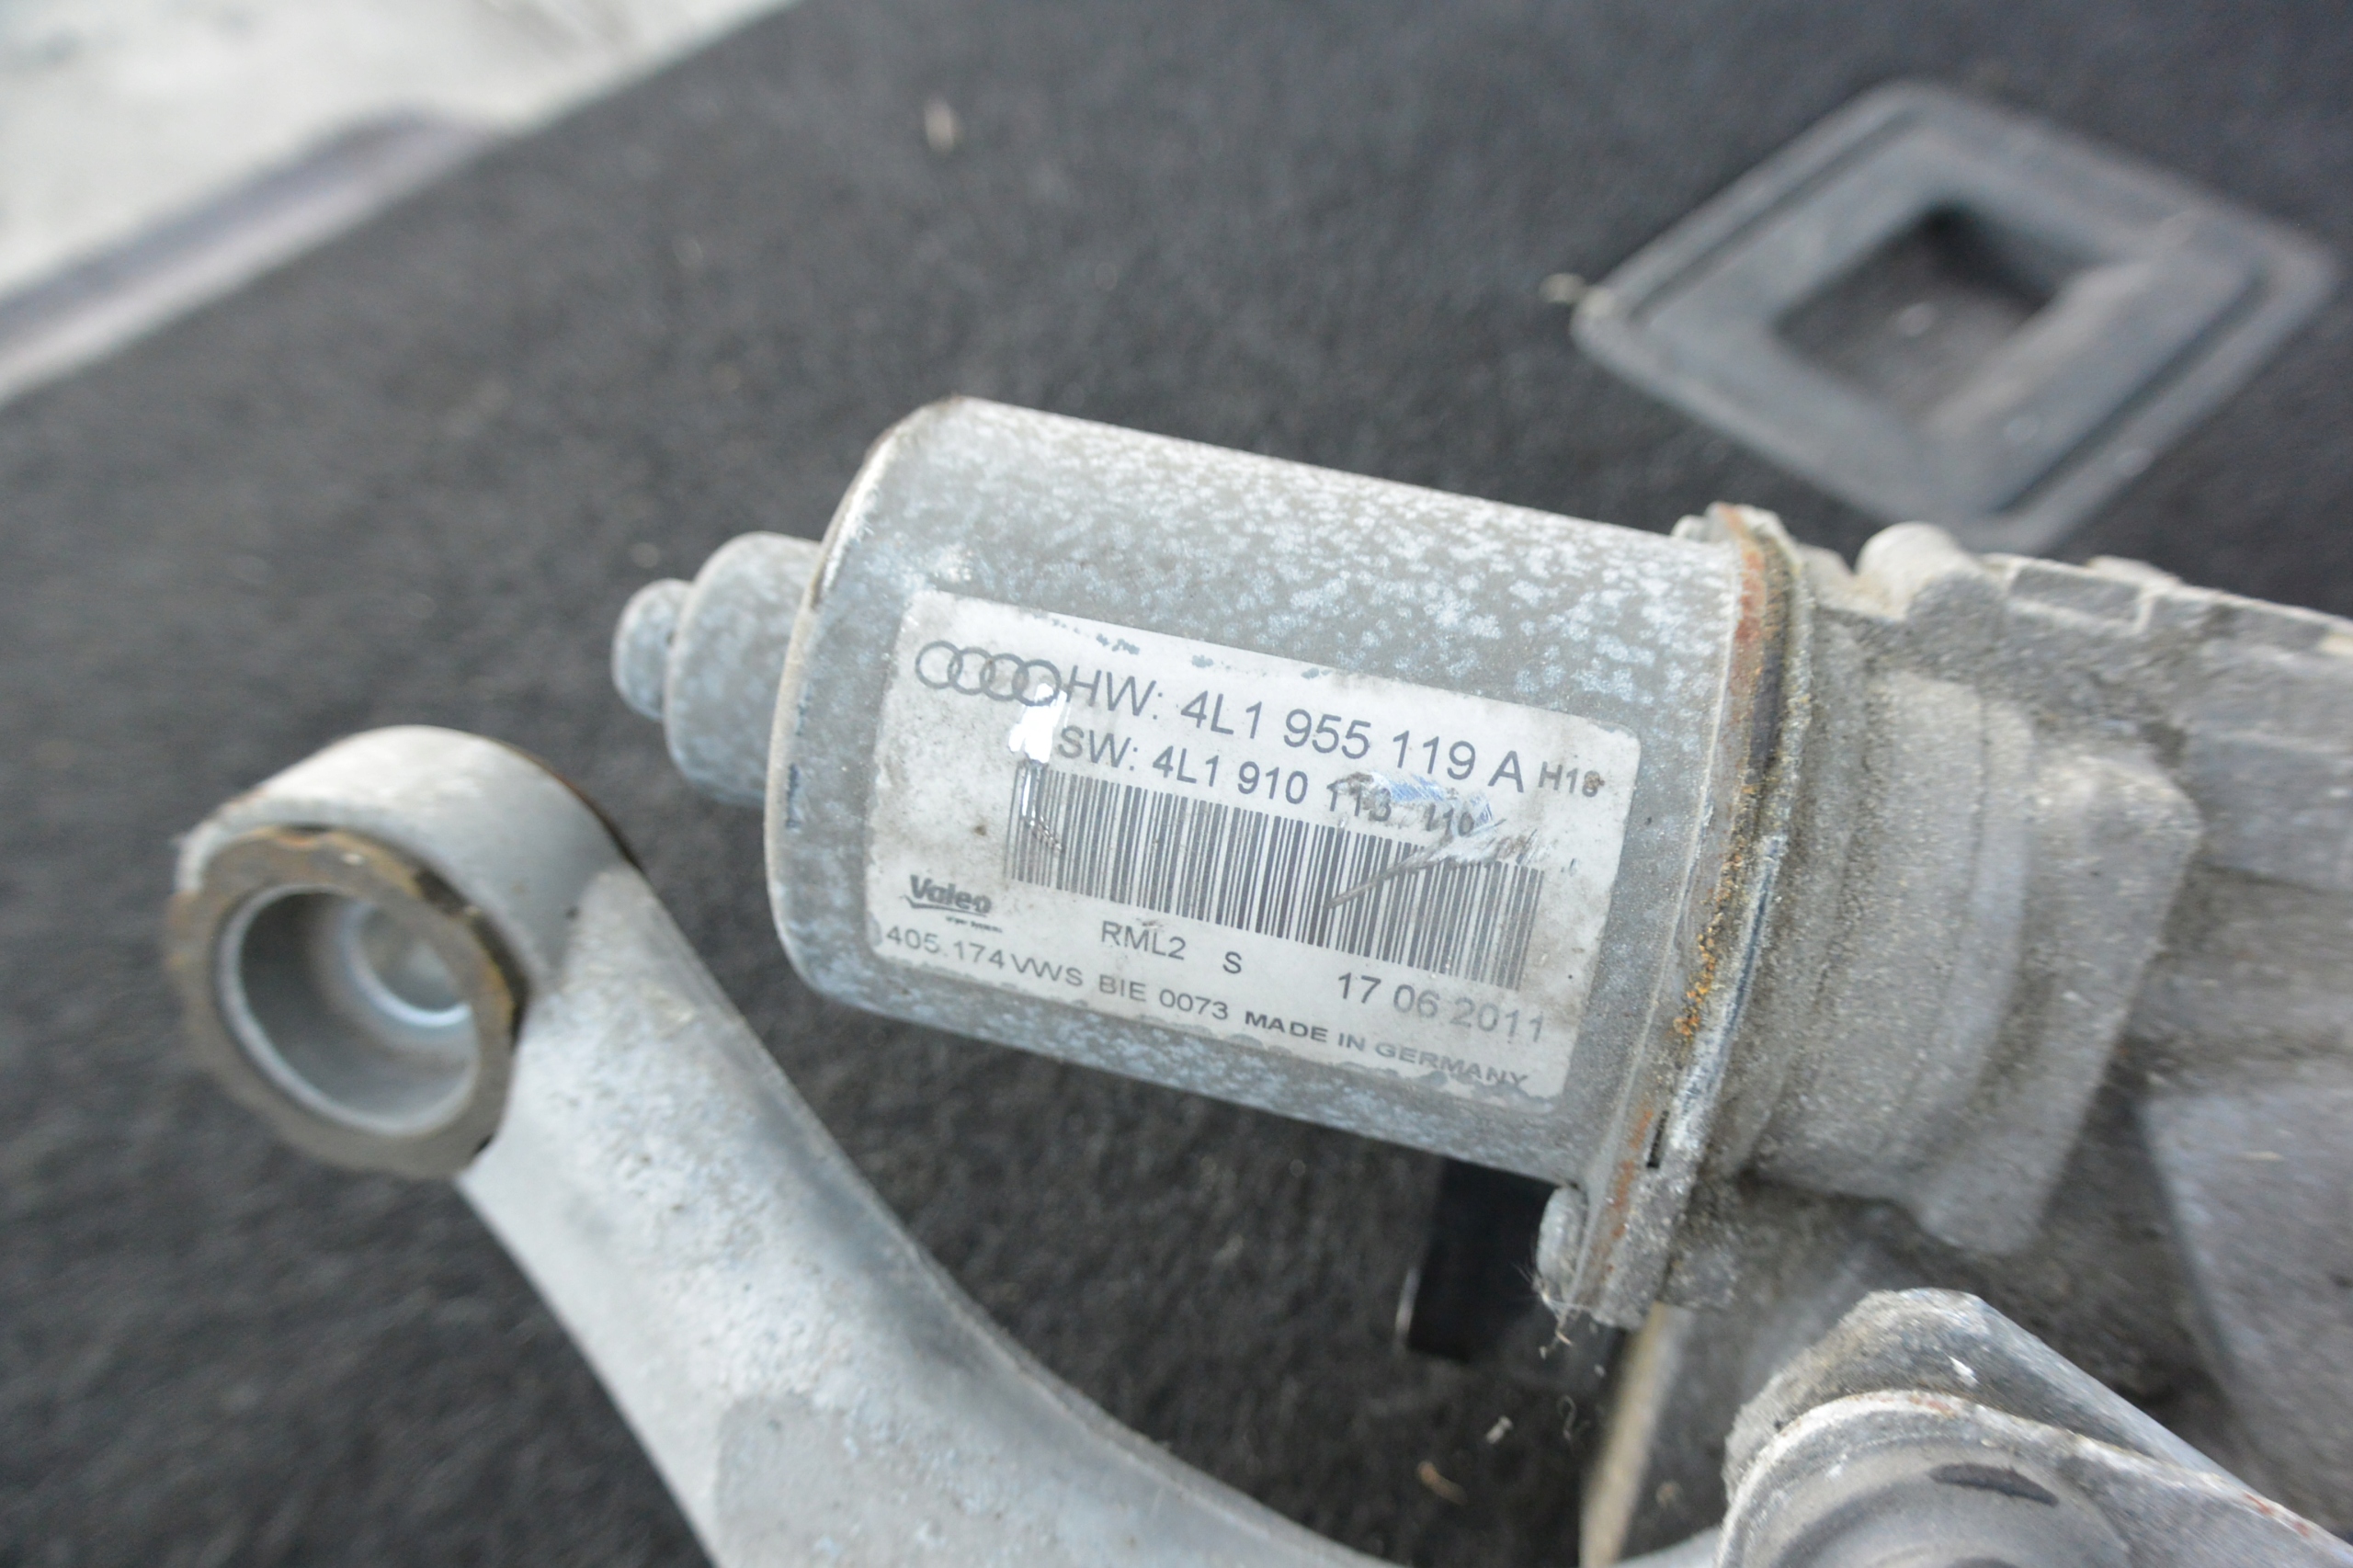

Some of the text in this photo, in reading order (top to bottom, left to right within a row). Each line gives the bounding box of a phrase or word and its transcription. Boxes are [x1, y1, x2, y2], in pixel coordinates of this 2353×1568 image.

[1058, 725, 1138, 771] SW:
[1153, 745, 1219, 787] 4L1
[1238, 761, 1308, 804] 910
[1066, 665, 1163, 720] HW:
[1180, 690, 1262, 739] 4L1
[1284, 709, 1370, 759] 955
[1392, 730, 1476, 780] 119
[1487, 750, 1524, 793] A
[910, 874, 993, 914] Valeo
[1101, 920, 1242, 974] RML2 S
[1098, 973, 1146, 1002] BIE
[1159, 988, 1229, 1020] 0073
[1337, 971, 1544, 1042] 17 06 2011
[1245, 1011, 1529, 1085] MADE IN GERMANY
